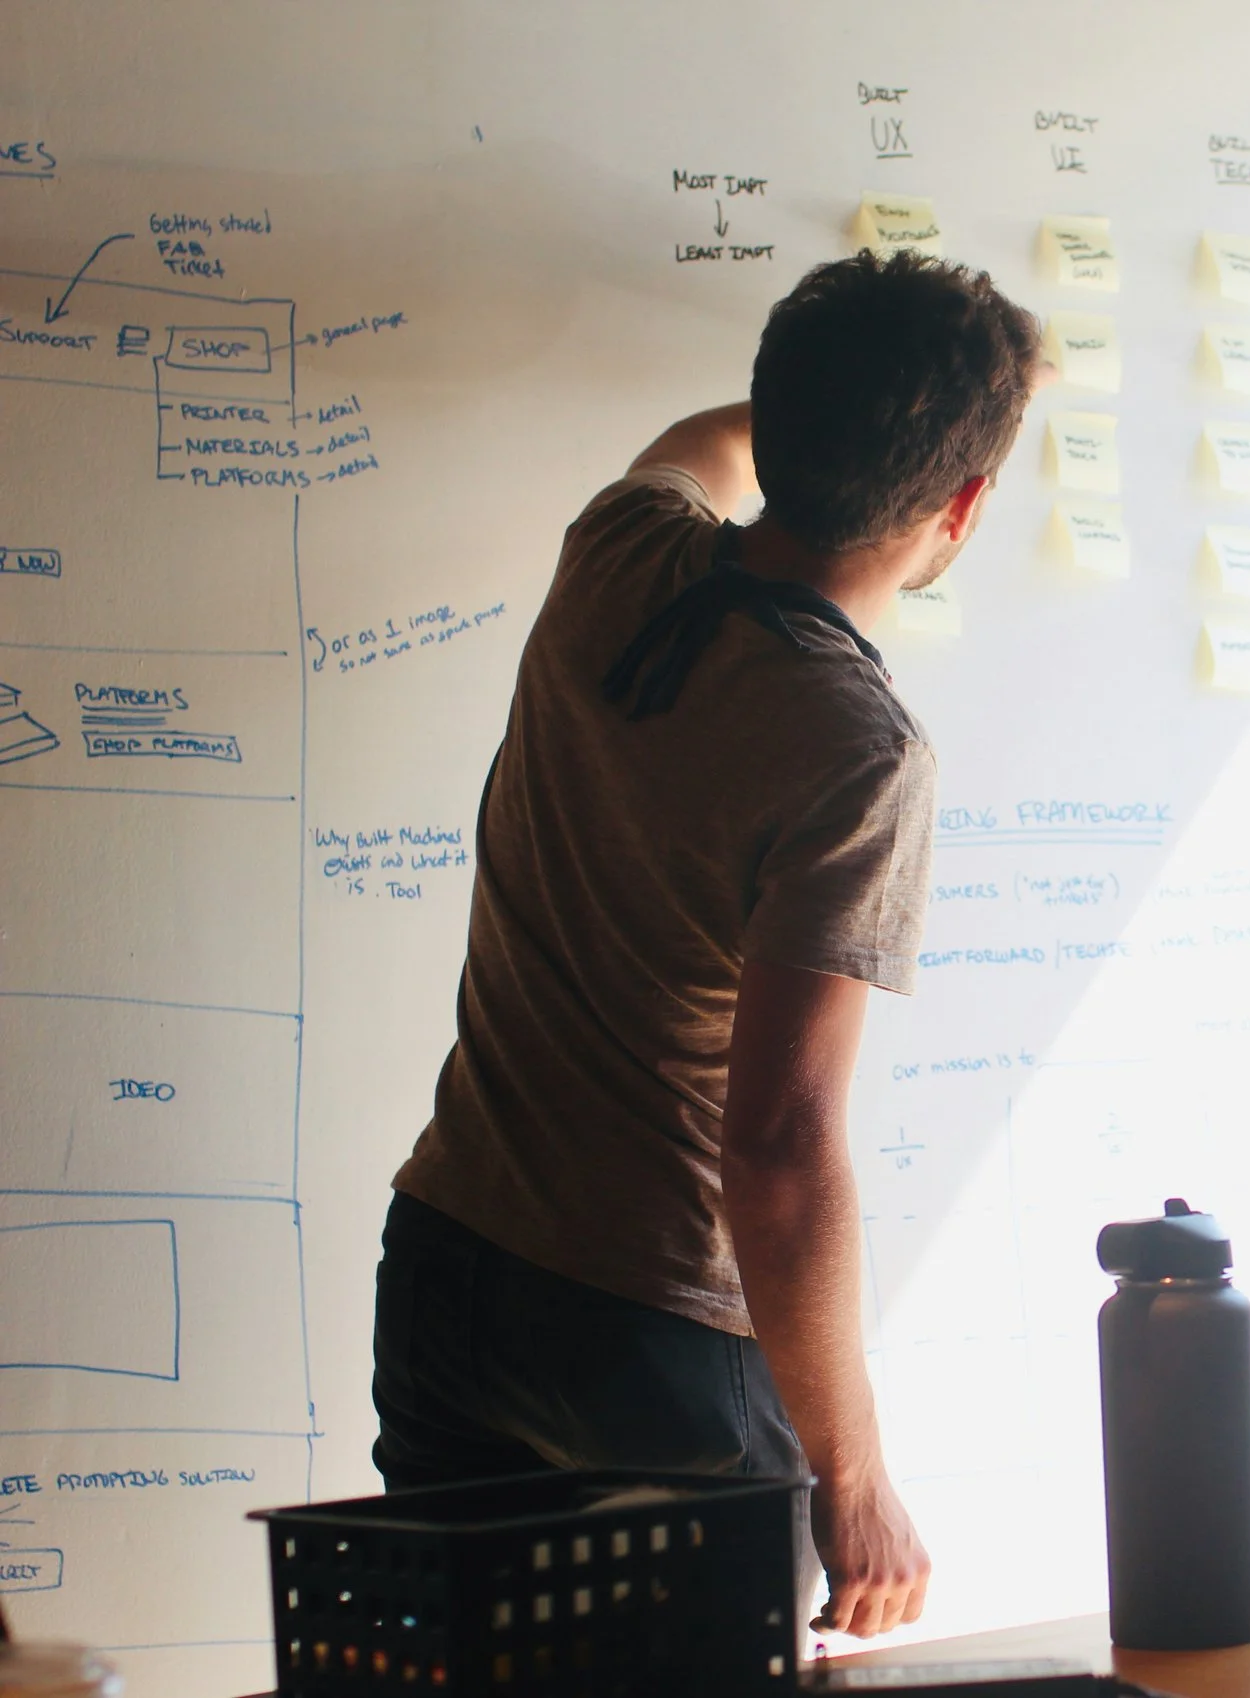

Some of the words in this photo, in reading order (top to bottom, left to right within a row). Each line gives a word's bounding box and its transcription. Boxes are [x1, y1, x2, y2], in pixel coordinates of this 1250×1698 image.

[870, 116, 908, 151] UX
[673, 168, 717, 192] MOST
[182, 338, 250, 359] SHOP
[181, 404, 270, 424] PRINTER
[185, 438, 300, 458] MATERIALS
[191, 466, 311, 488] PLATFORMS
[332, 635, 350, 654] or
[358, 629, 377, 645] as
[1016, 800, 1175, 825] FRAMEWORK
[315, 827, 350, 857] Why
[385, 881, 422, 898] Tool
[892, 1063, 921, 1081] Our
[931, 1057, 991, 1074] mission
[109, 1079, 175, 1101] IDEO
